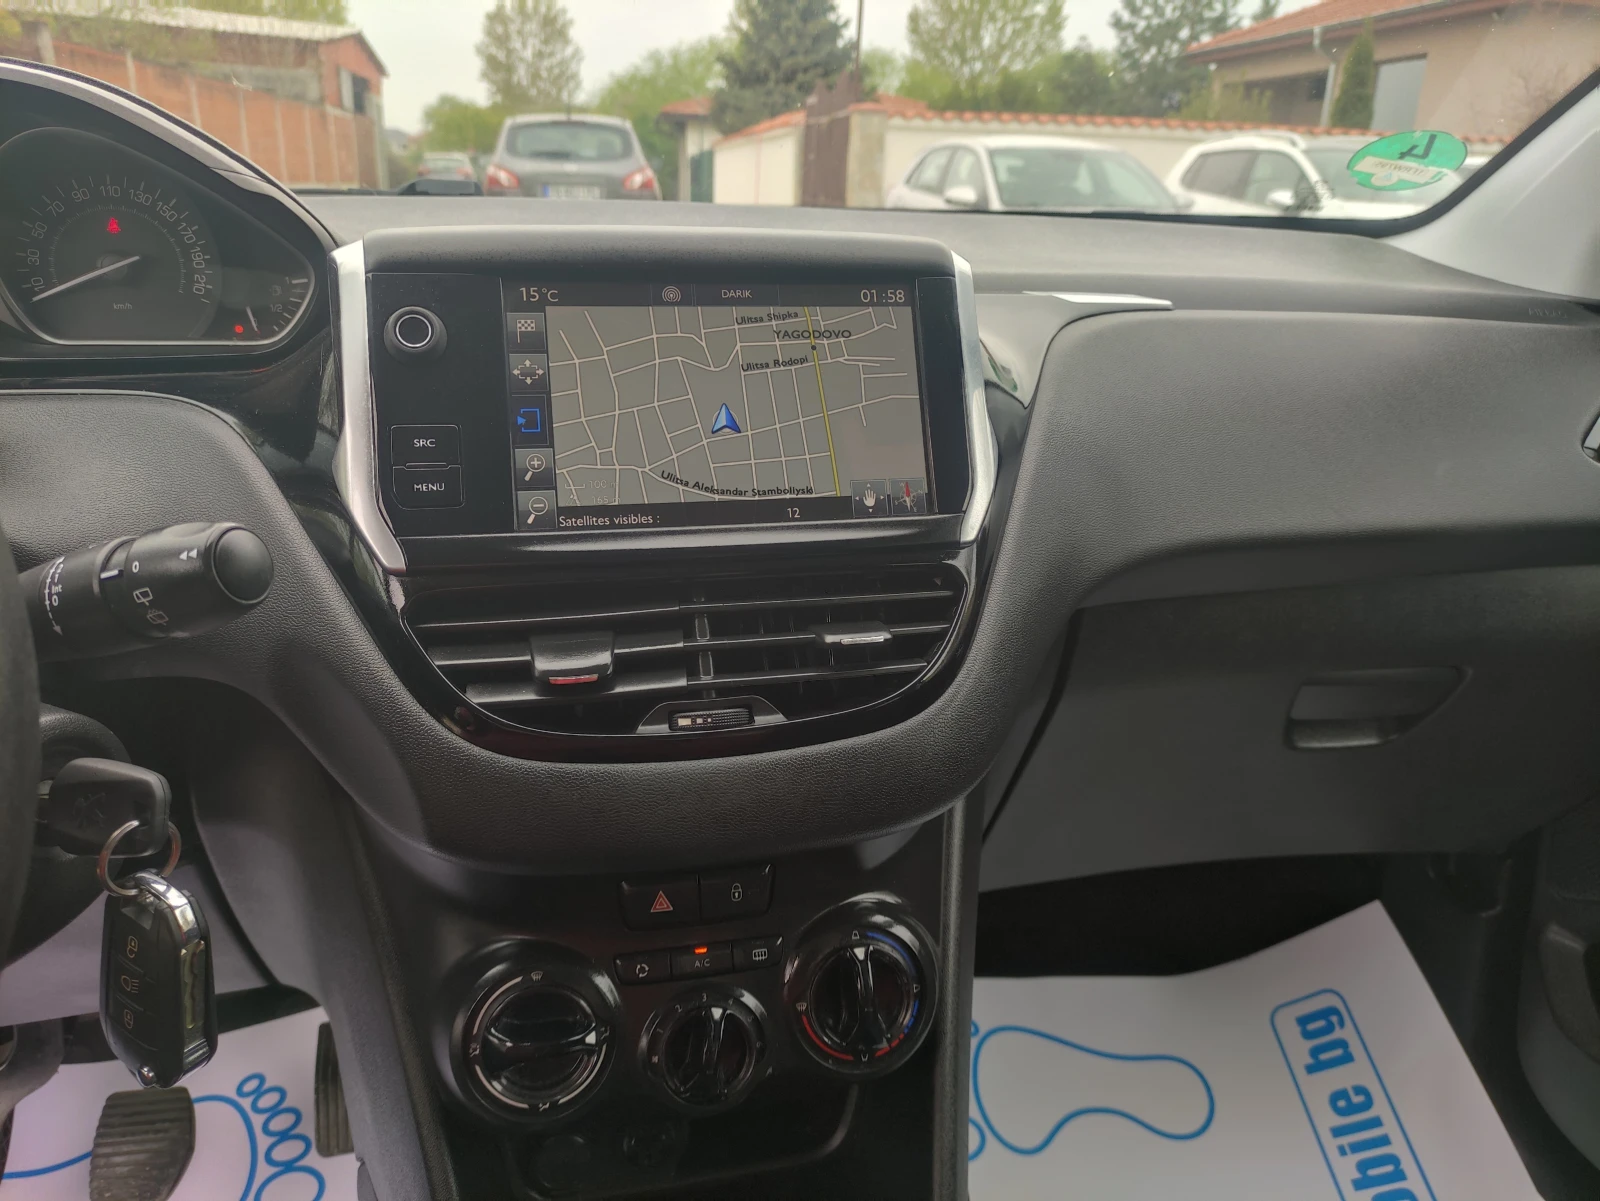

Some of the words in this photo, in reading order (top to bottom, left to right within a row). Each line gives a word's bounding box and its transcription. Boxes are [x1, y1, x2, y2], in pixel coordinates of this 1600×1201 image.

[71, 187, 90, 202] 90
[100, 186, 121, 198] 110
[128, 188, 153, 206] 130
[48, 200, 65, 217] 70
[156, 200, 178, 222] 150
[32, 222, 48, 239] 50
[177, 222, 196, 244] 170
[27, 249, 40, 266] 30
[190, 247, 206, 269] 190
[30, 277, 44, 292] 10
[192, 274, 206, 295] 210
[721, 289, 753, 299] DARIK
[860, 289, 905, 303] 01:58
[113, 301, 133, 311] km/h
[270, 304, 283, 312] 1/2
[735, 314, 764, 326] Ulitsa
[767, 311, 799, 323] Shipka
[773, 329, 852, 340] YAGODOVO
[741, 361, 770, 373] Ulitsa
[774, 355, 809, 368] Rodopi
[413, 439, 436, 448] SRC
[413, 483, 445, 492] MENU
[589, 479, 607, 489] 100
[660, 470, 690, 488] Ulitsa
[693, 481, 749, 496] Aleksandar
[752, 485, 814, 497] Stamboliyski
[559, 515, 610, 527] Satellites
[613, 514, 654, 525] visibles
[787, 507, 800, 518] 12
[51, 584, 62, 594] Int
[694, 958, 711, 968] A/C
[701, 992, 707, 1002] 3
[1295, 1005, 1355, 1075] bg
